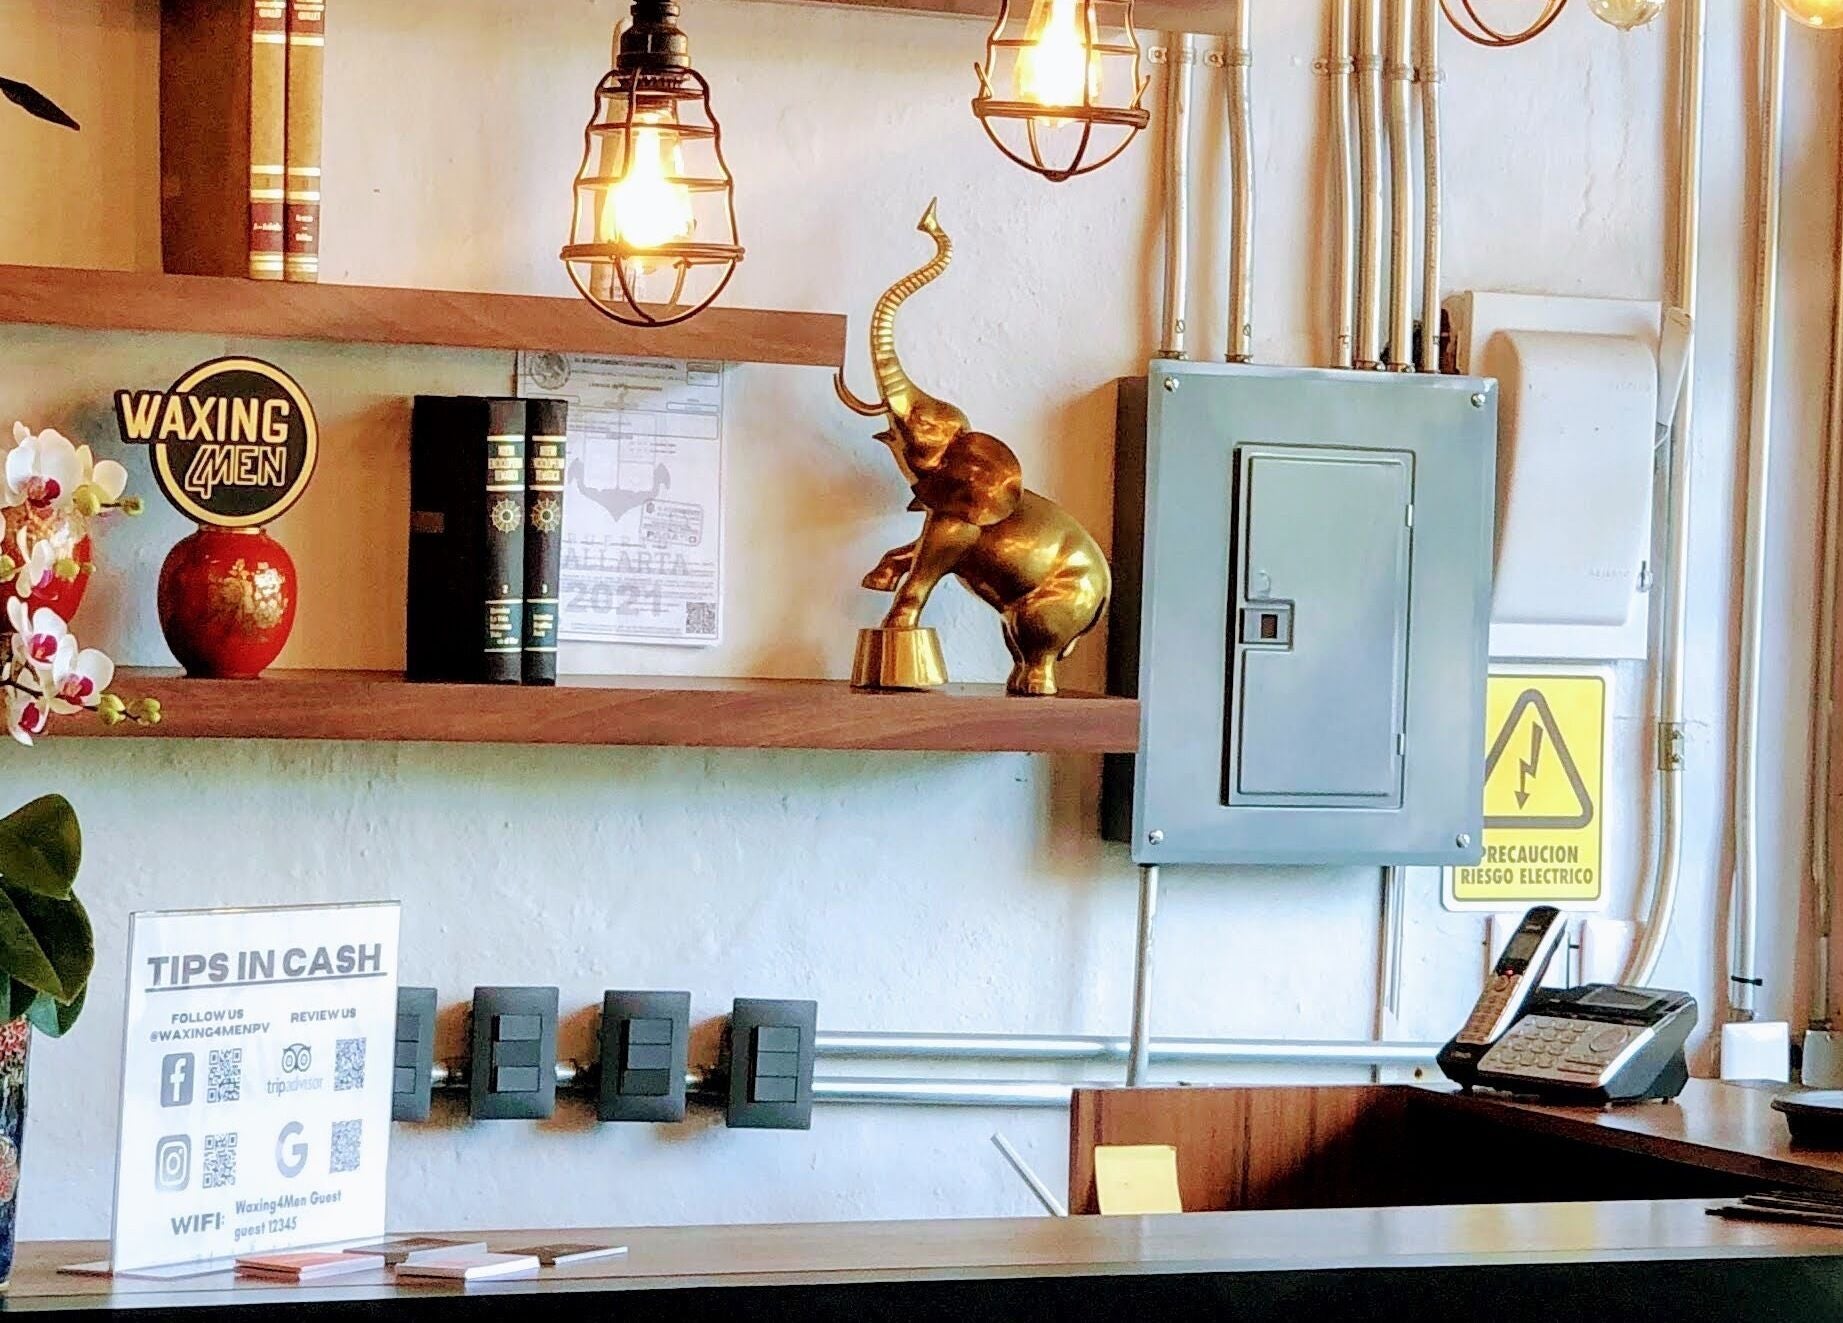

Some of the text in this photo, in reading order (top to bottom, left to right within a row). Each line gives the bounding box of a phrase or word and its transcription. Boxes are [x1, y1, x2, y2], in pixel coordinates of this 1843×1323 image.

[121, 393, 290, 443] WAXING
[185, 444, 287, 499] 4MEN
[562, 548, 690, 576] ALLARTA
[566, 582, 663, 616] 2021
[1460, 868, 1594, 885] RIESGO ELECTRICO
[147, 943, 382, 986] TIPS IN CASH
[171, 1009, 244, 1024] FOLLOW US
[290, 1008, 357, 1024] REVIEW US
[151, 1023, 271, 1042] @WAXING4MENPV
[235, 1190, 342, 1215] Waxing4Men Guest
[171, 1212, 225, 1236] WIFI:
[234, 1216, 298, 1242] guest 12345
